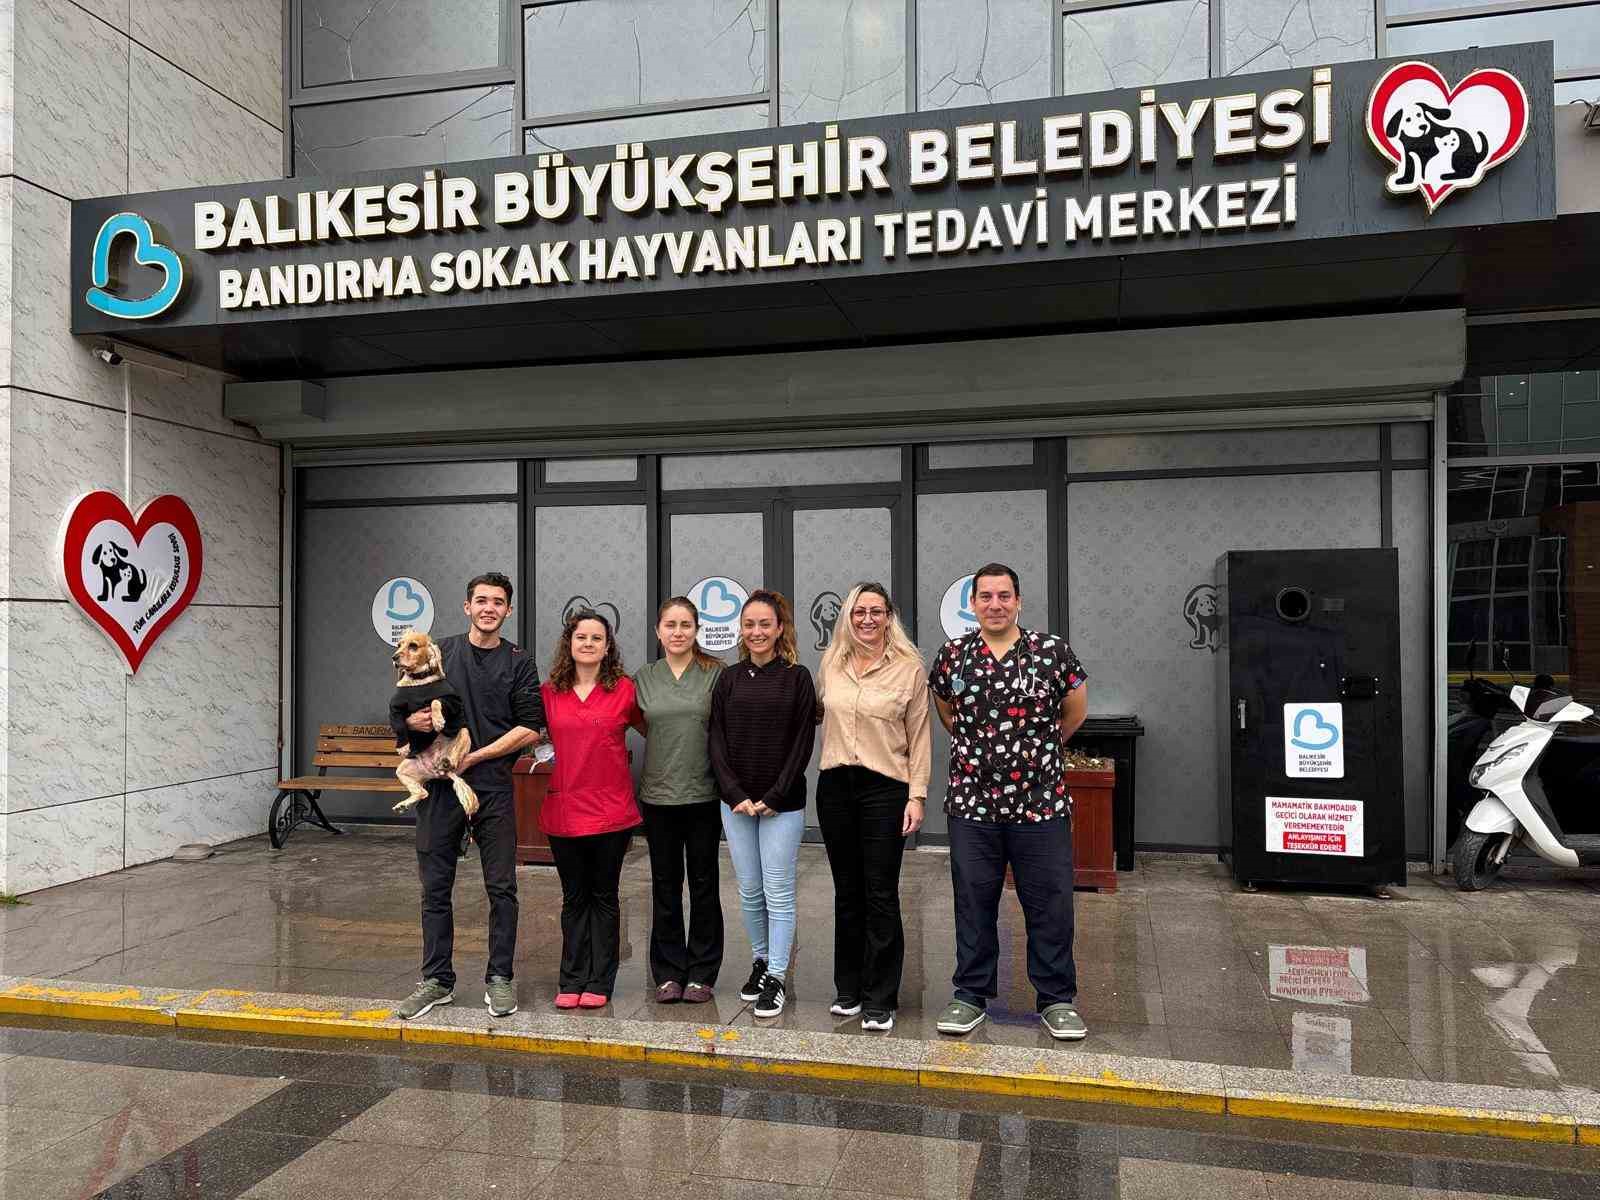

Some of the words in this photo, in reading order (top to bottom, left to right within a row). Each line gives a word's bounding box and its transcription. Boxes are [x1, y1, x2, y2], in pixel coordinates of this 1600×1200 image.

[194, 171, 480, 250] BALIKESİR
[494, 124, 891, 224] BÜYÜKŞEHİR
[908, 67, 1332, 187] BELEDİYESİ
[219, 256, 423, 309] BANDIRMA
[430, 240, 571, 293] SOKAK
[579, 215, 863, 281] HAYVANLARI
[874, 187, 1050, 258] TEDAVİ
[1064, 162, 1297, 243] MERKEZİ
[1271, 800, 1313, 810] MAMAMATİK
[1314, 803, 1358, 812] BAKIMDADIR
[1275, 811, 1297, 820] GEÇİCİ
[1299, 812, 1327, 820] OLARAK
[1328, 813, 1353, 822] HİZMET
[1283, 821, 1345, 831] VEREMEMEKTEDİR
